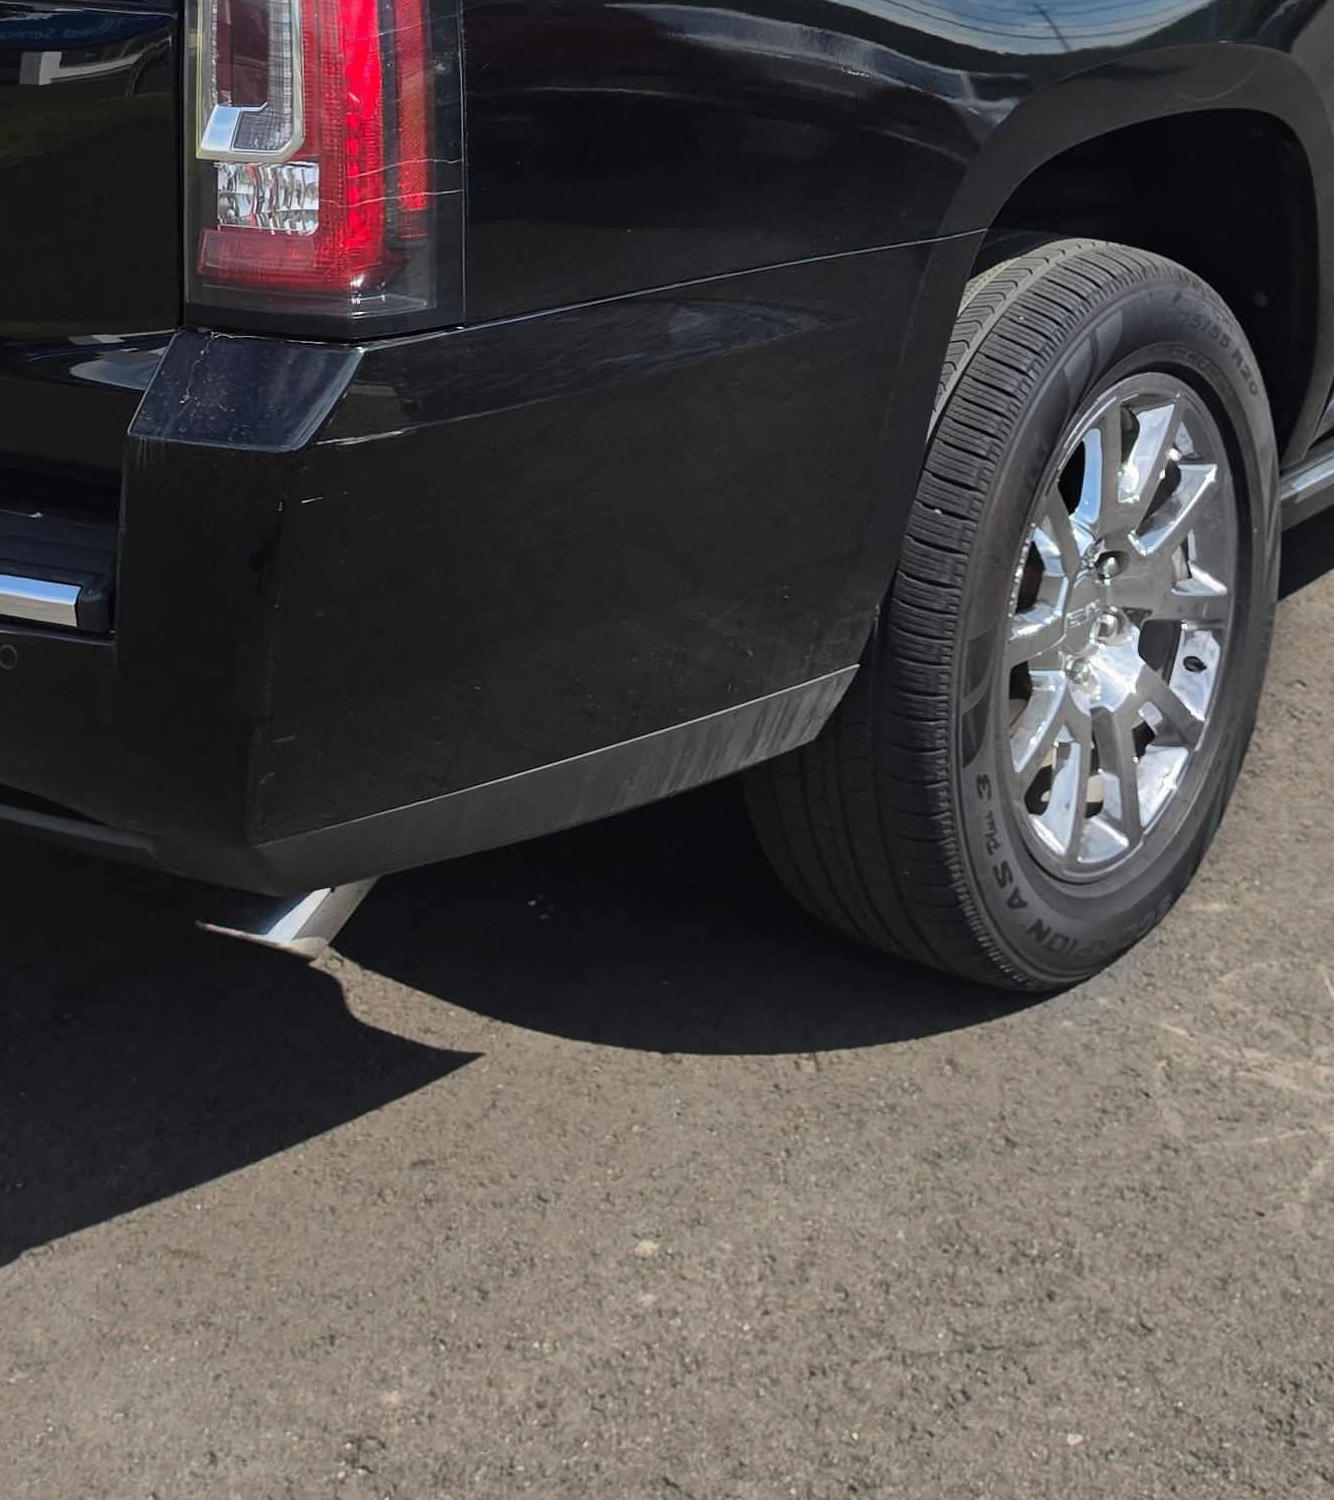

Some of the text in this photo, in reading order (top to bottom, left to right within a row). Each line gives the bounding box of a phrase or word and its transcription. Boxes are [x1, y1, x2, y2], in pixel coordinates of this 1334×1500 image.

[1230, 348, 1259, 396] R20
[975, 774, 992, 800] 3
[984, 811, 1002, 855] Plus
[992, 860, 1029, 910] AS
